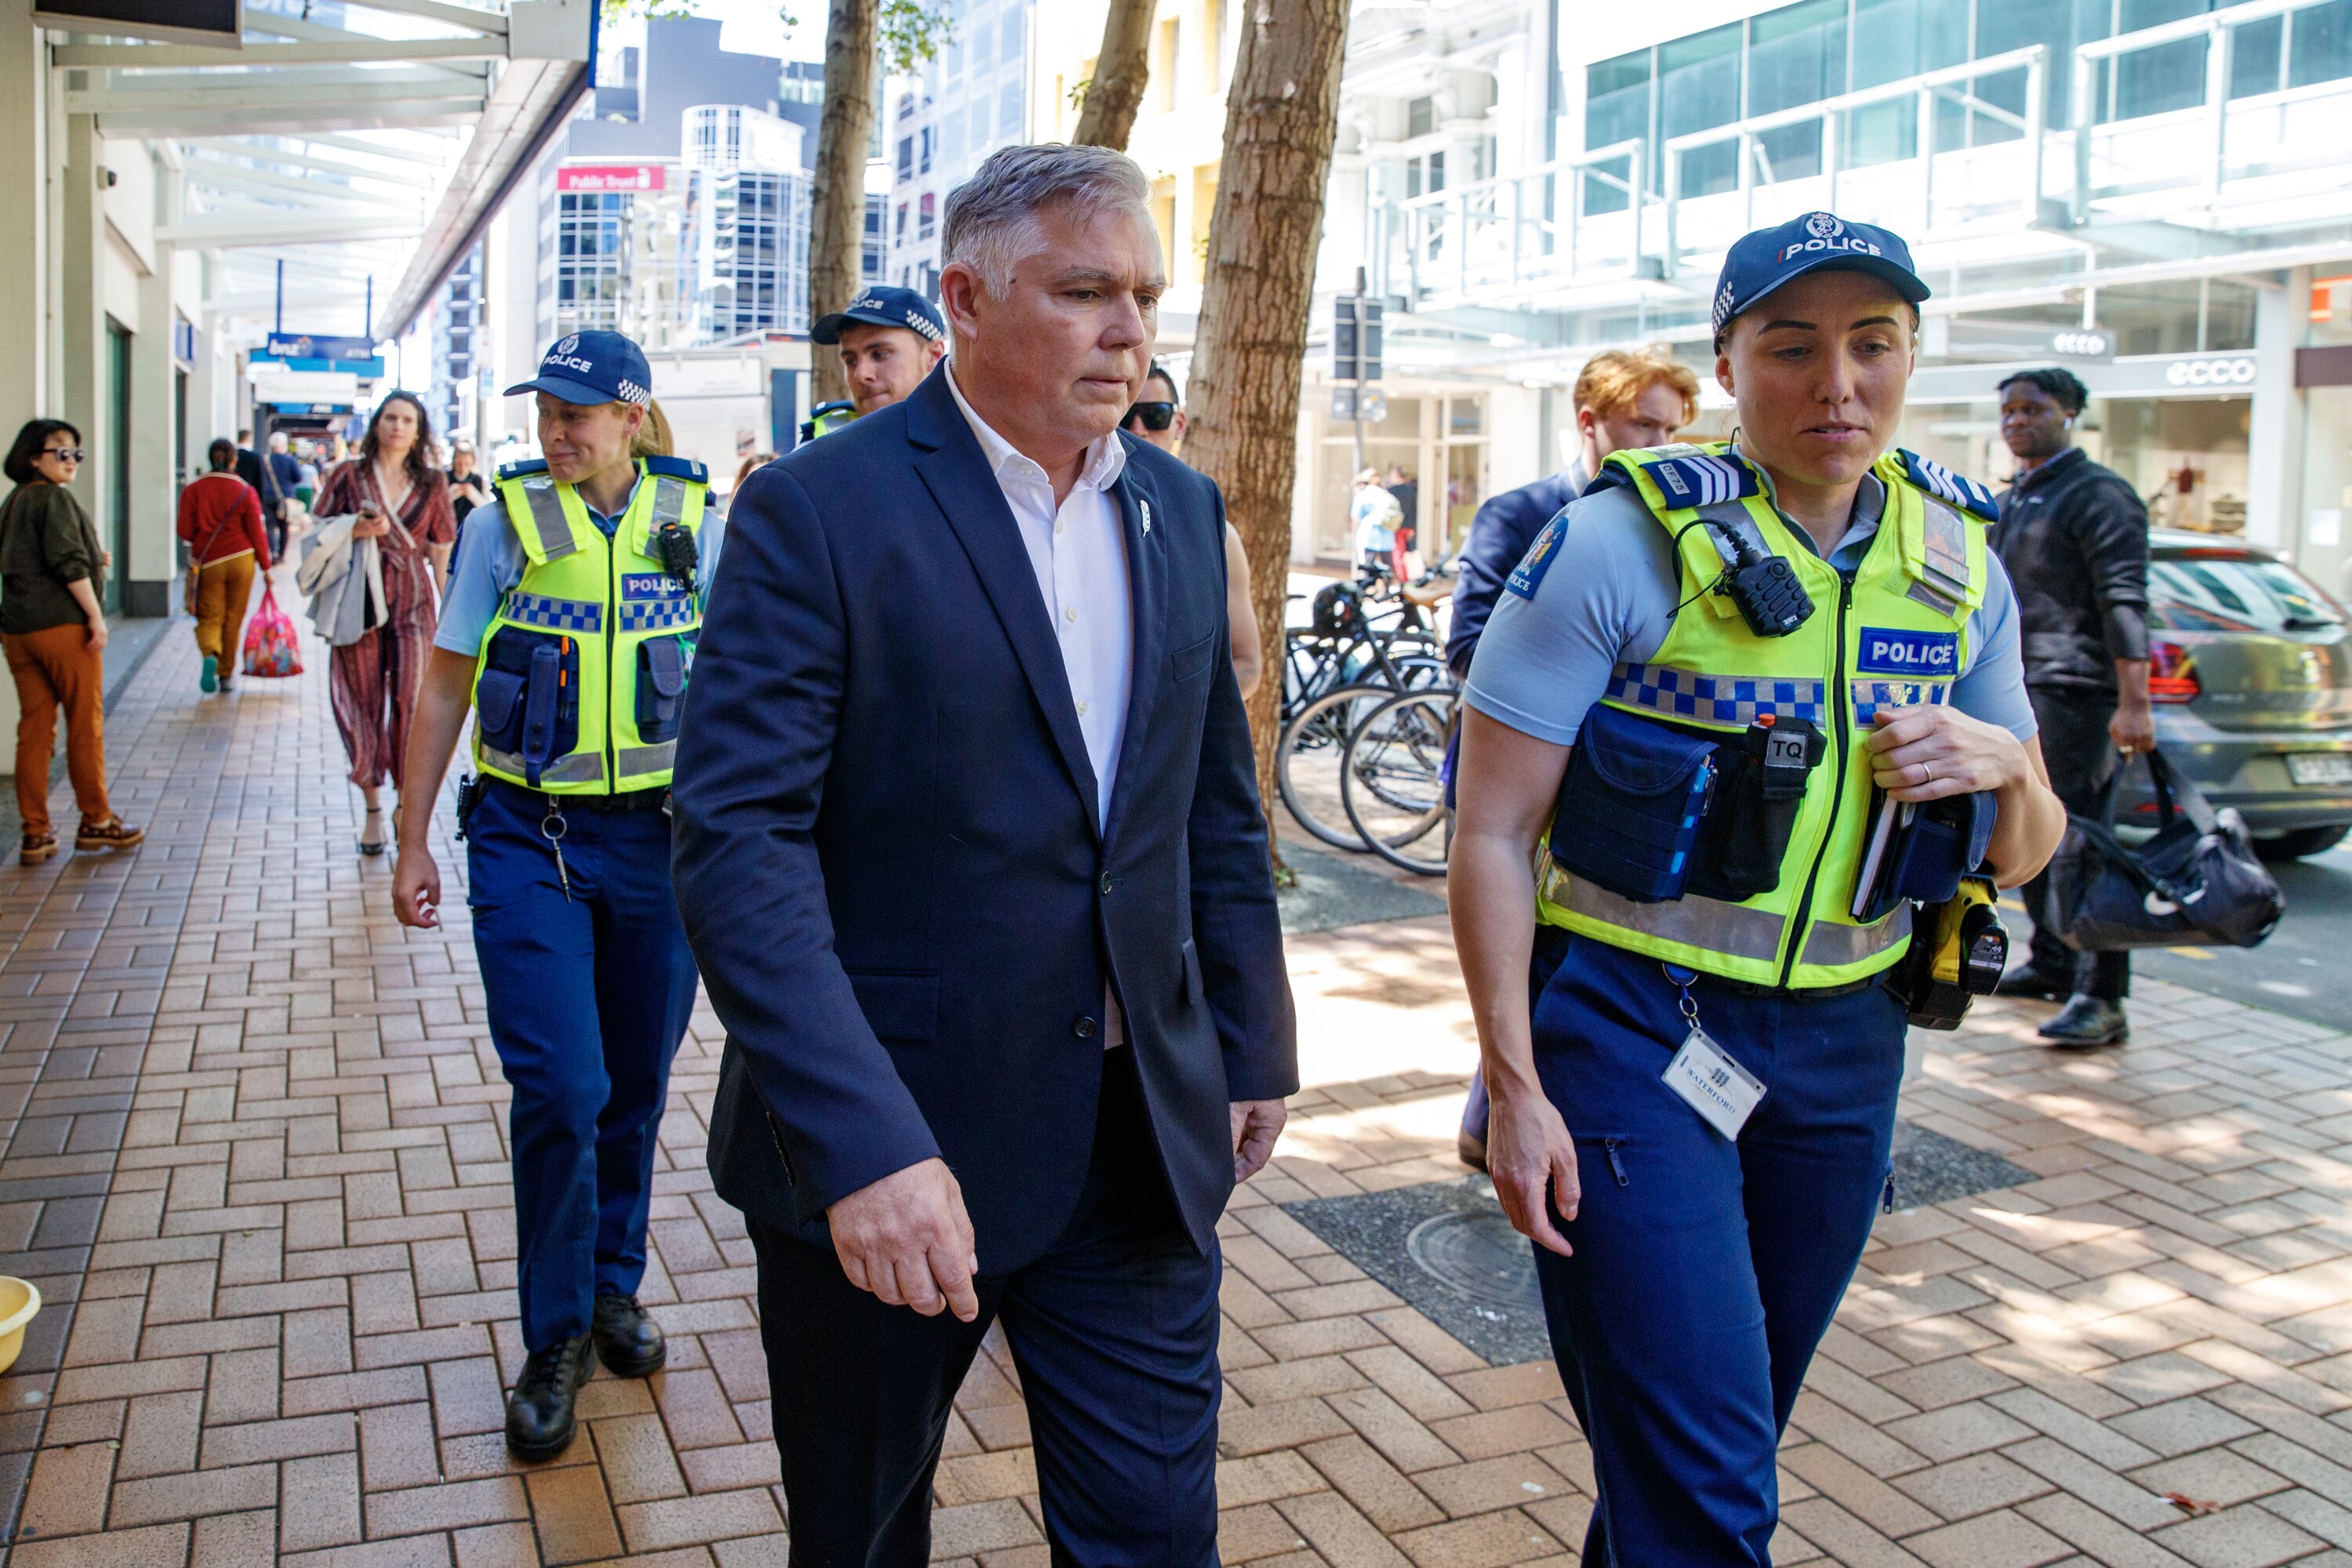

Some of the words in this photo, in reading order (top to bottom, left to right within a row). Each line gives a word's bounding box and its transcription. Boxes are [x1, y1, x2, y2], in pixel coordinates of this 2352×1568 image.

[569, 175, 603, 189] Public
[606, 175, 636, 189] Trust
[1785, 238, 1882, 260] POLICE
[2054, 332, 2105, 354] ecco
[2166, 358, 2256, 386] ecco
[1871, 641, 1954, 665] POLICE
[1773, 740, 1802, 759] TQ
[1688, 1067, 1737, 1113] WATERFORD
